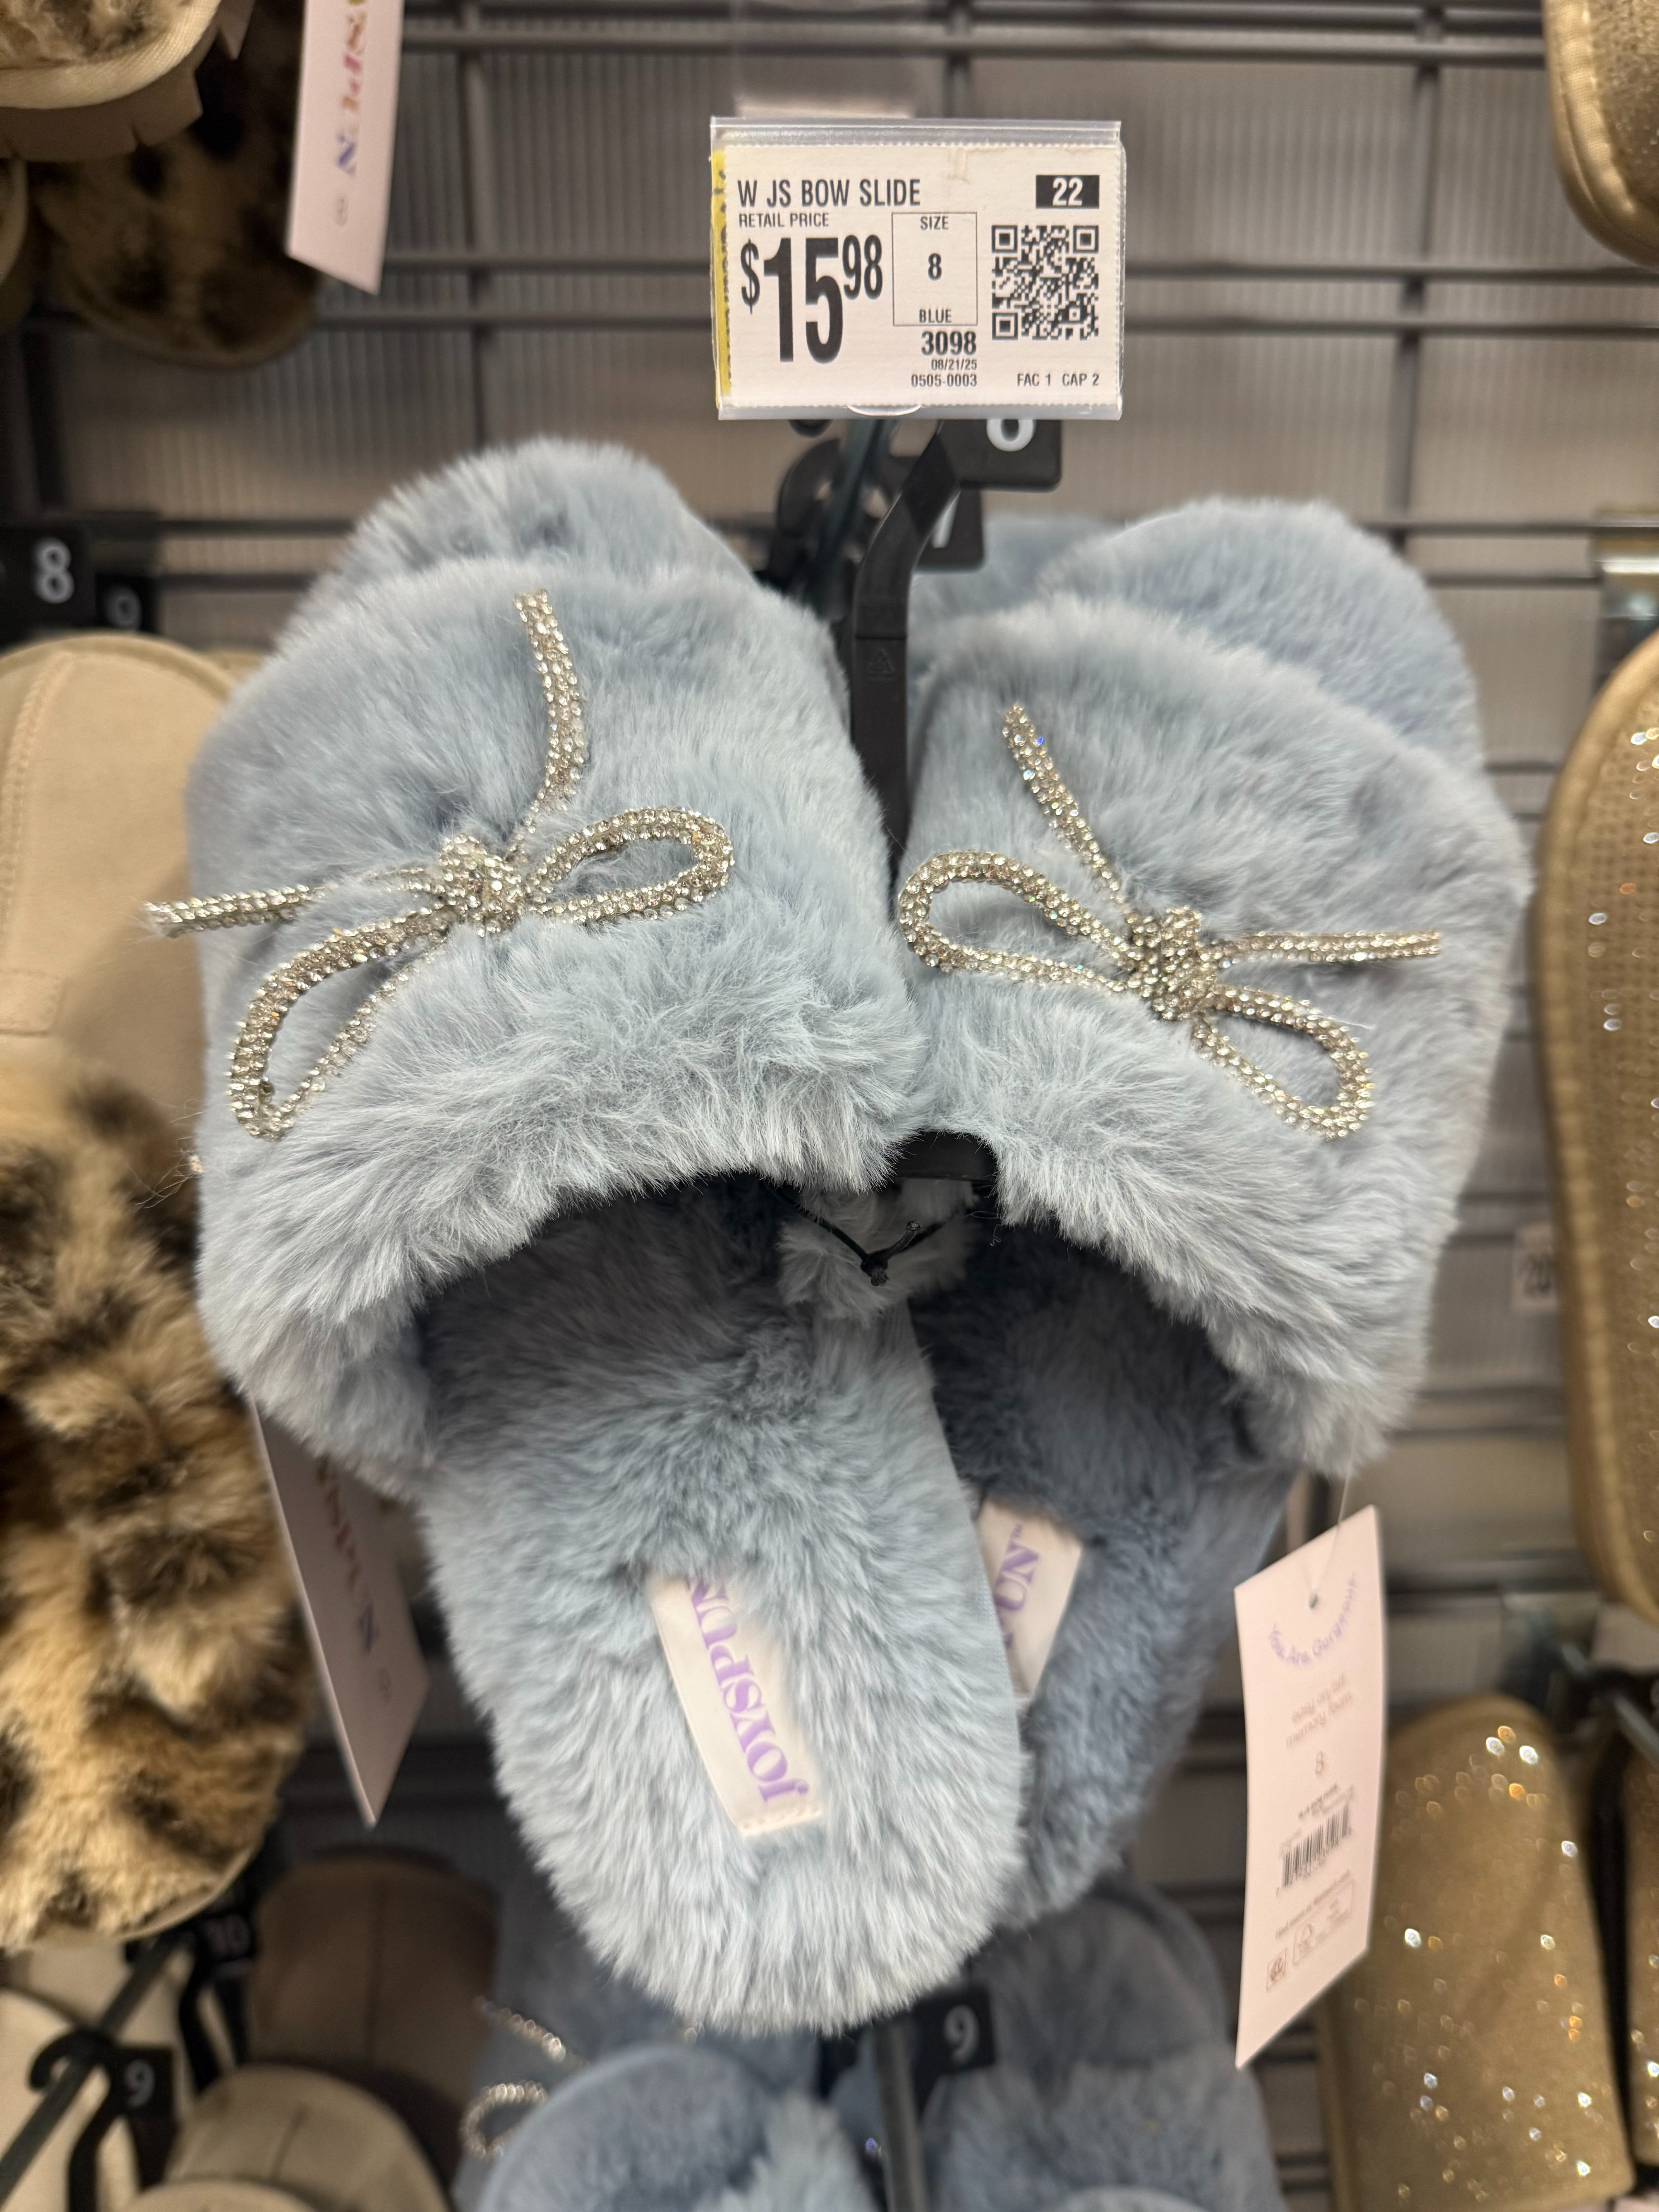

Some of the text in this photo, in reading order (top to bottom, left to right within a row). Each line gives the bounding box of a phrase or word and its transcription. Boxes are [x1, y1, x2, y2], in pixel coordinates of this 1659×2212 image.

[737, 179, 920, 207] W JS BOW SLIDE
[1052, 178, 1083, 206] 22
[738, 213, 828, 227] RETAIL PRICE
[921, 216, 948, 230] SIZE
[928, 253, 942, 280] 8
[919, 309, 952, 323] BLUE
[921, 330, 977, 356] 3098
[931, 359, 977, 371] 08/21/25
[911, 374, 977, 387] 0505-0003
[1017, 373, 1100, 386] FAC 1 CAP 2
[35, 537, 74, 603] 8
[944, 2005, 979, 2064] 9
[124, 2059, 155, 2107] 9
